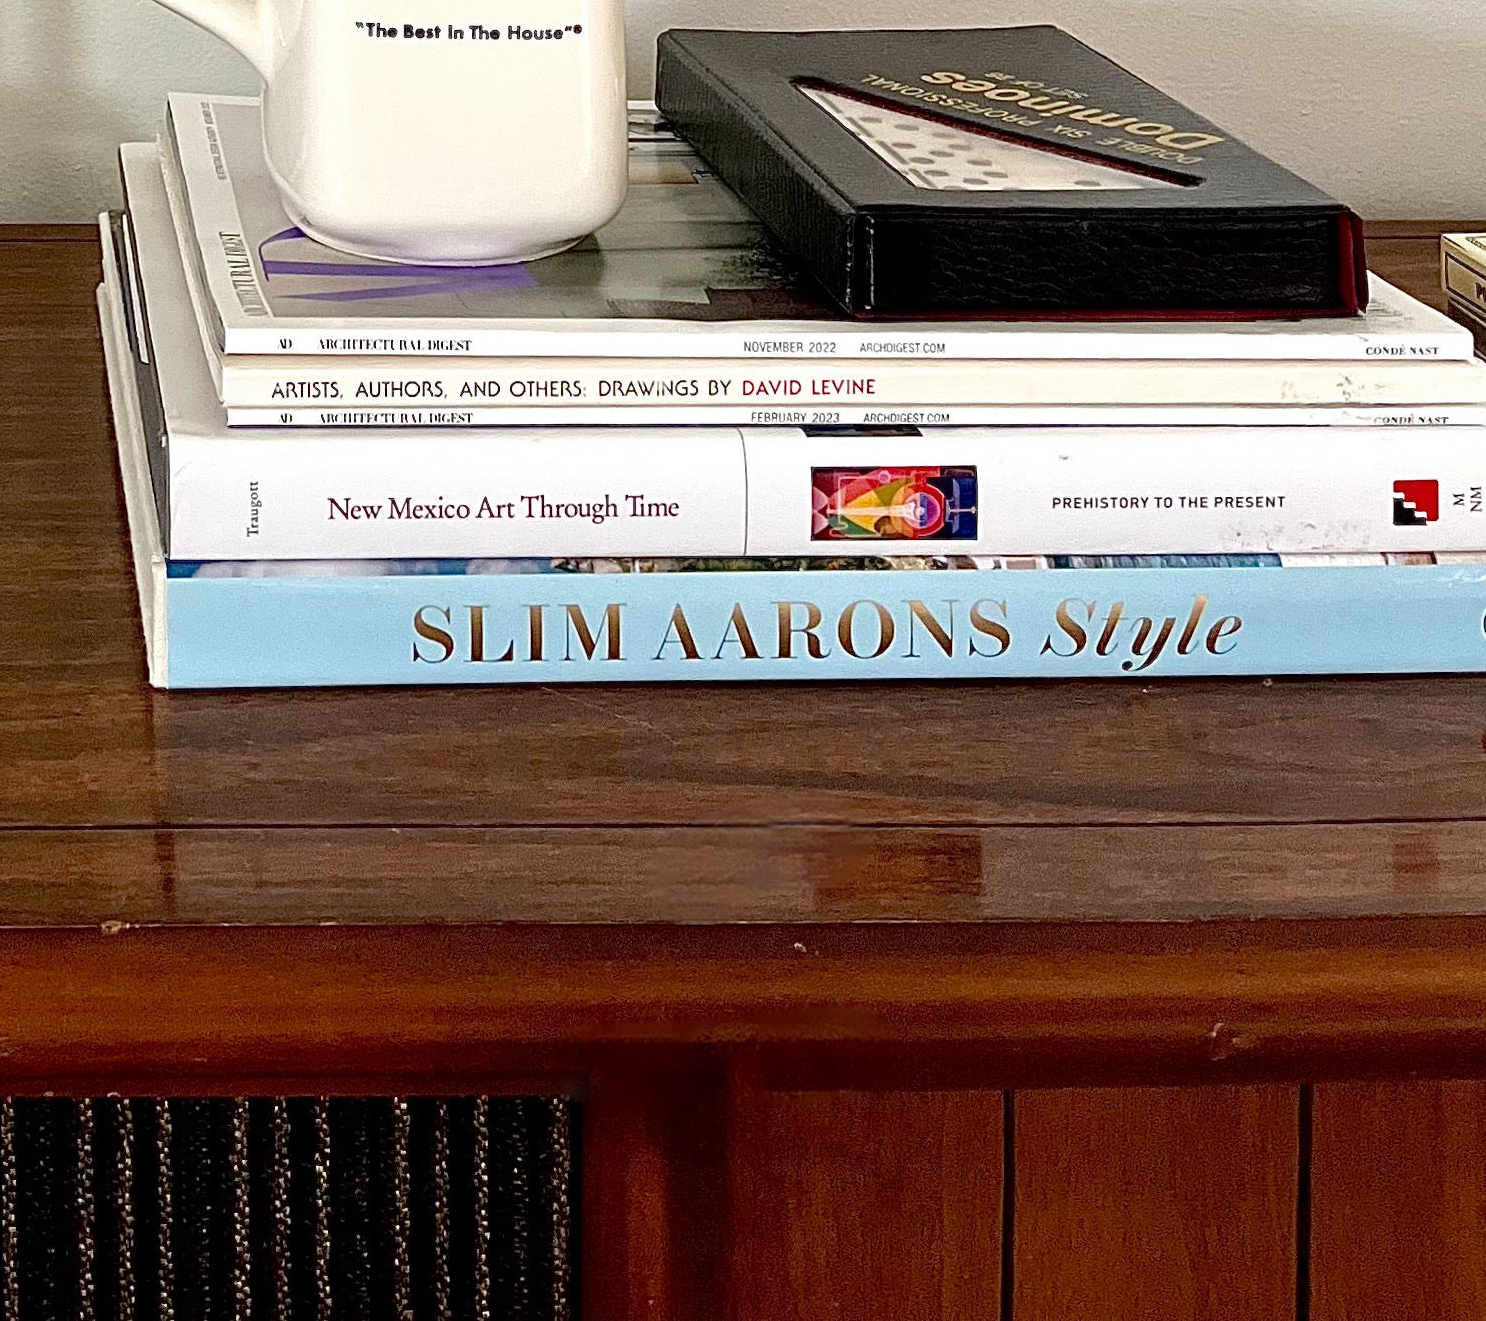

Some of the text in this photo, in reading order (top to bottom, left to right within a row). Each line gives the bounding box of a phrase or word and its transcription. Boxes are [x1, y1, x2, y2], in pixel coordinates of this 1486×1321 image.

[355, 21, 398, 39] "The
[403, 24, 441, 40] Best
[447, 25, 464, 40] In
[469, 25, 501, 40] The
[861, 73, 1204, 165] DOUBLE SIX PROFESSIONAL
[920, 71, 1226, 151] Dominoes
[277, 338, 473, 351] AD ARCHITECTURAL DIGEST
[743, 341, 946, 354] NOVEMBER 2022 ARCHDIGEST.COM
[1365, 343, 1439, 356] CONDÉ NAST
[271, 378, 876, 400] ARTISTS, AUTHORS, AND OTHERS: DRAWINGS BY DAVID LEVINE
[278, 412, 474, 424] AD ARCHITECTURAL DIGEST
[751, 411, 950, 424] FEBRUARY 2023 ARCHDIGEST.COM
[1417, 415, 1450, 425] NAST
[246, 481, 263, 538] Traugott
[327, 493, 680, 525] New Mexico Art Through Time
[1052, 495, 1287, 510] PREHISTORY TO THE PRESENT
[412, 593, 1243, 672] SLIM AARONS Style
